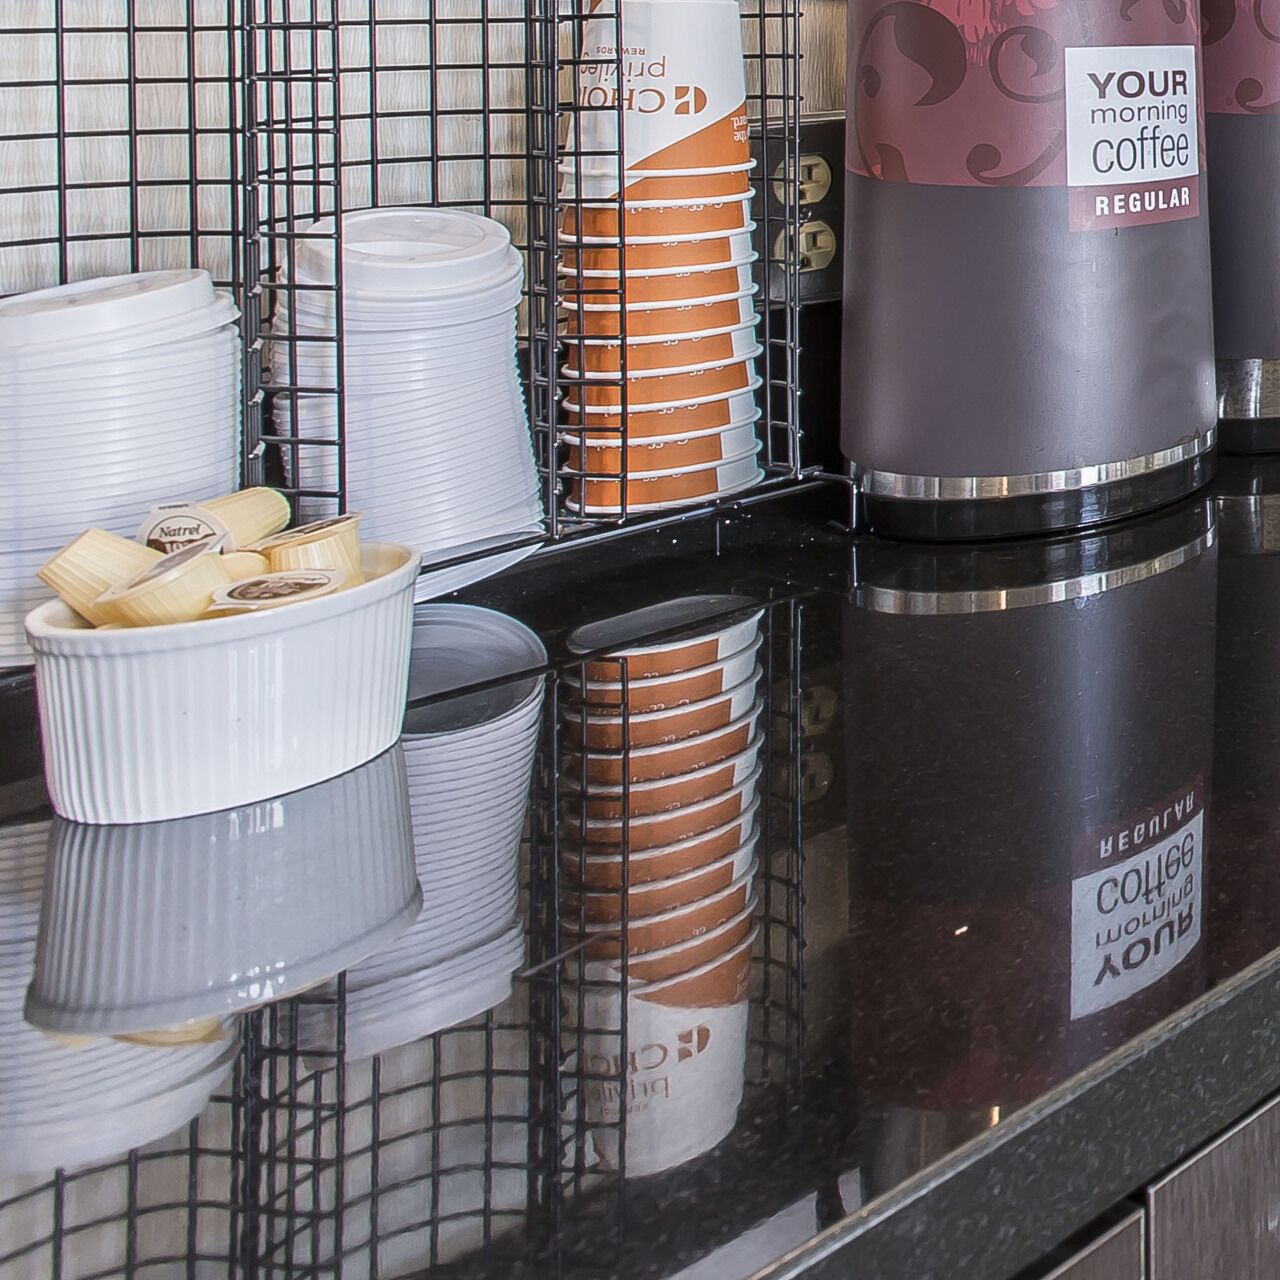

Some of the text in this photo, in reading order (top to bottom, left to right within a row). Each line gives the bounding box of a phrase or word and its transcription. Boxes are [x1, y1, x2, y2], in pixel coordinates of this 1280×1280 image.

[1087, 70, 1188, 99] YOUR
[1091, 100, 1187, 124] morning
[1092, 125, 1189, 173] coffee
[1095, 186, 1190, 216] REGULAR
[158, 523, 202, 538] Natrel
